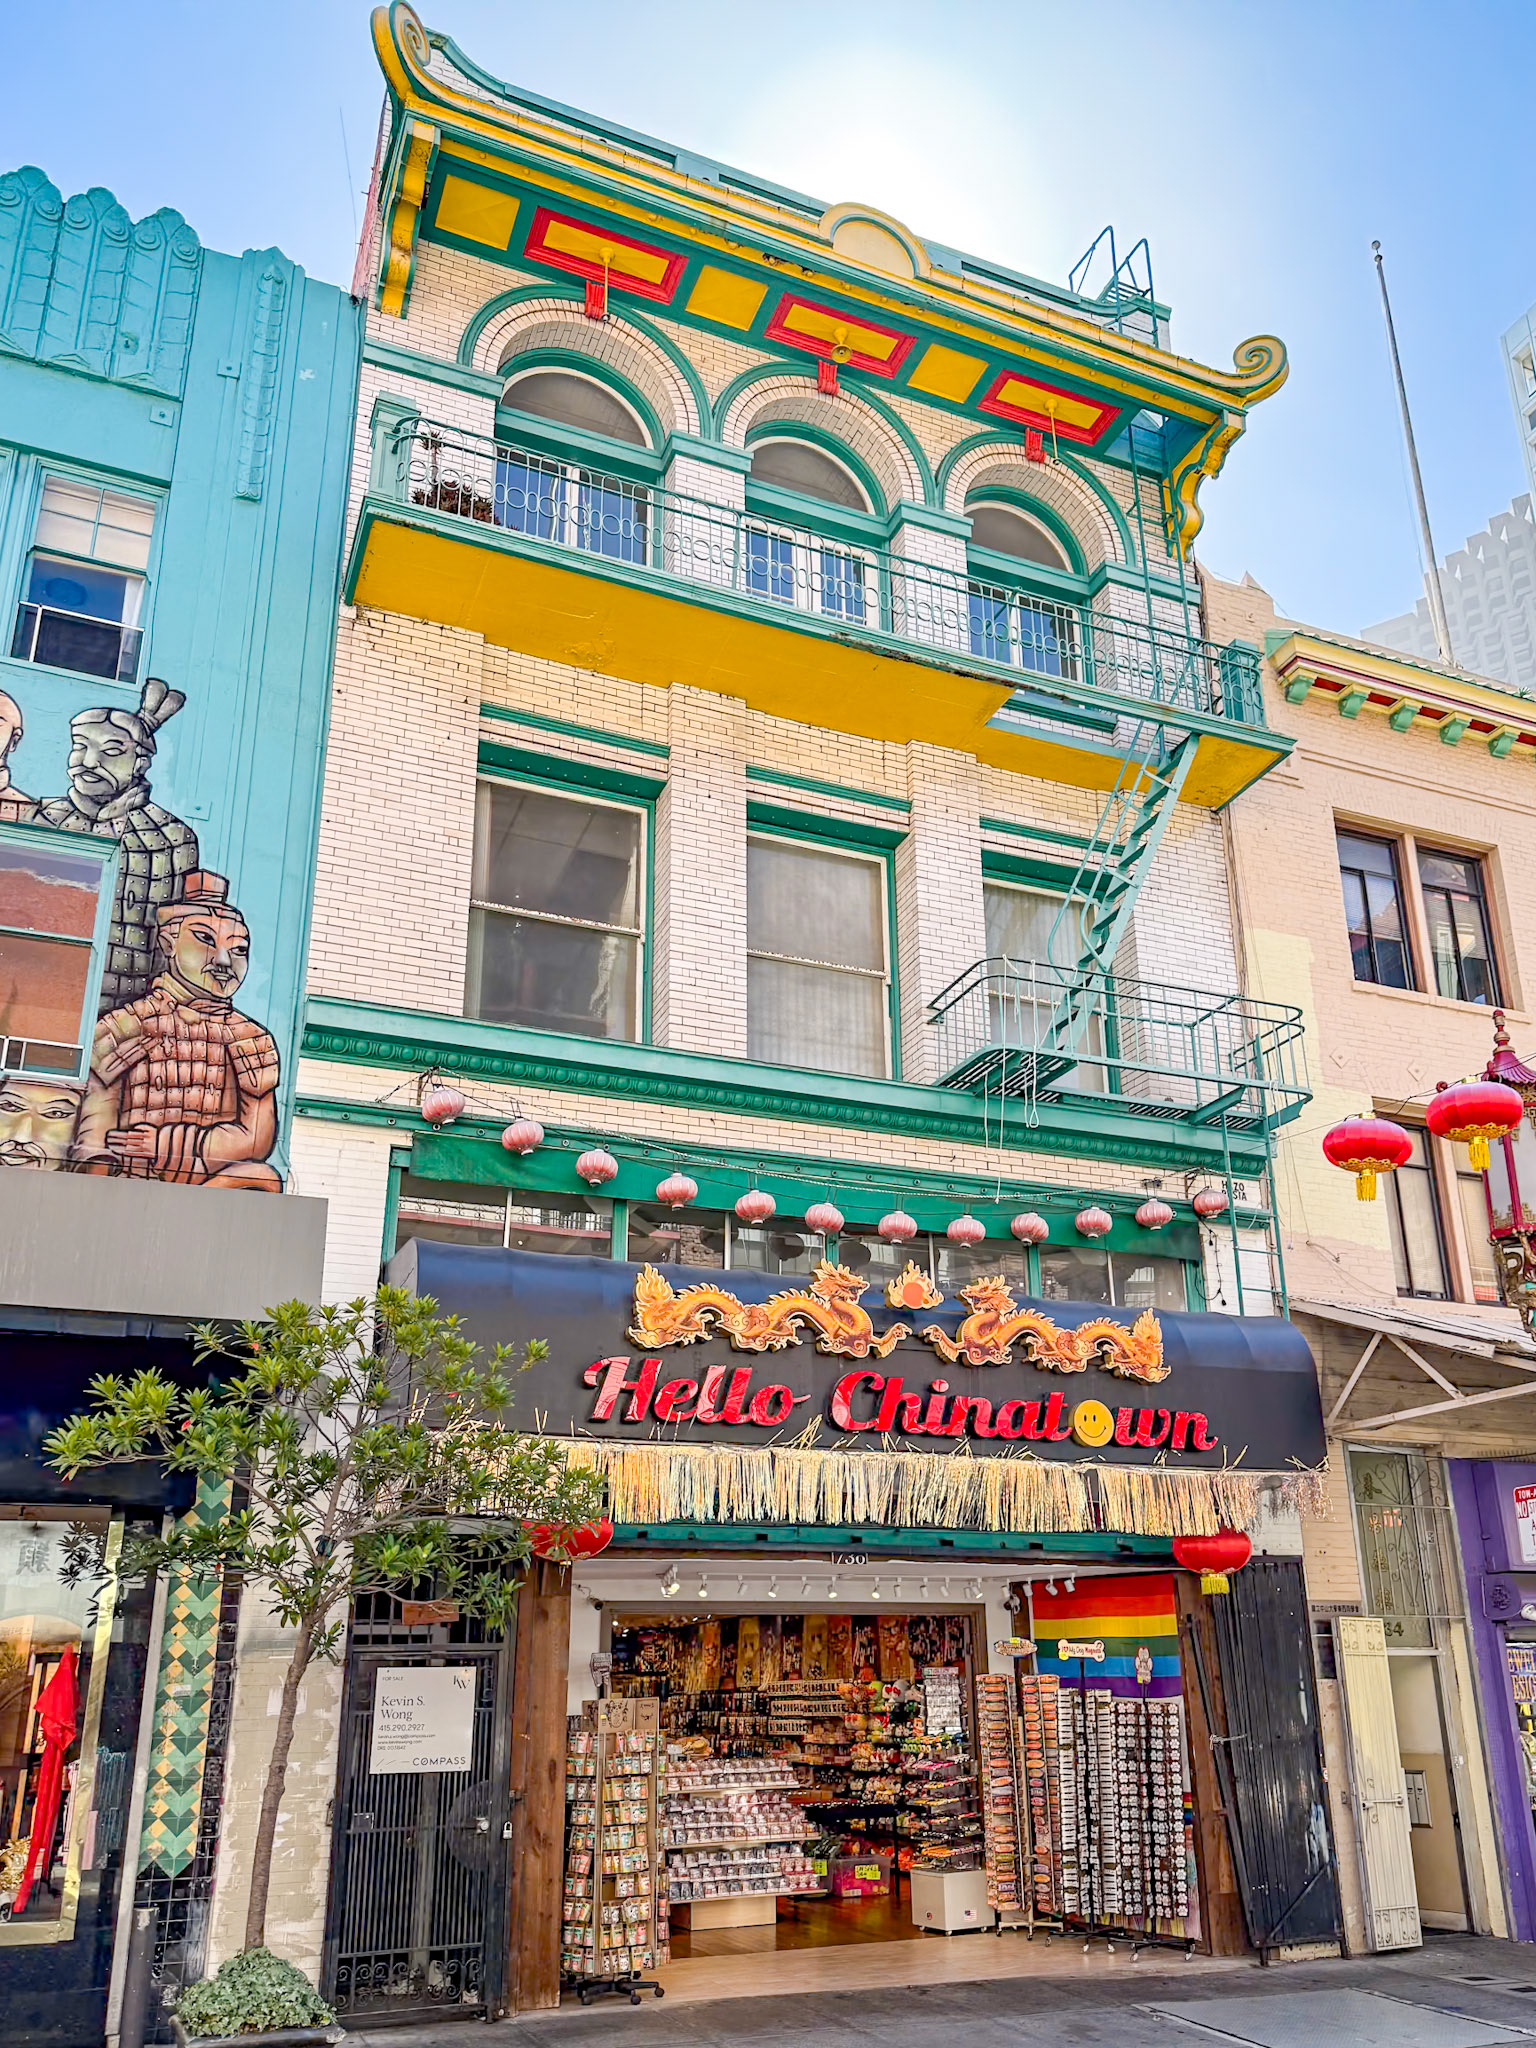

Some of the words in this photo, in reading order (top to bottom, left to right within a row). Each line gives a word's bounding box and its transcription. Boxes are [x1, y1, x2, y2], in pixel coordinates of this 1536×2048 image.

[1221, 1180, 1245, 1192] HZO
[1221, 1190, 1247, 1201] SIA
[583, 1356, 811, 1426] Hello
[1516, 1500, 1529, 1518] NO
[381, 1695, 414, 1706] Kevin
[416, 1695, 425, 1706] S.
[381, 1709, 413, 1721] Wong
[379, 1723, 425, 1732] 415.290.2927
[412, 1756, 466, 1766] COMPASS
